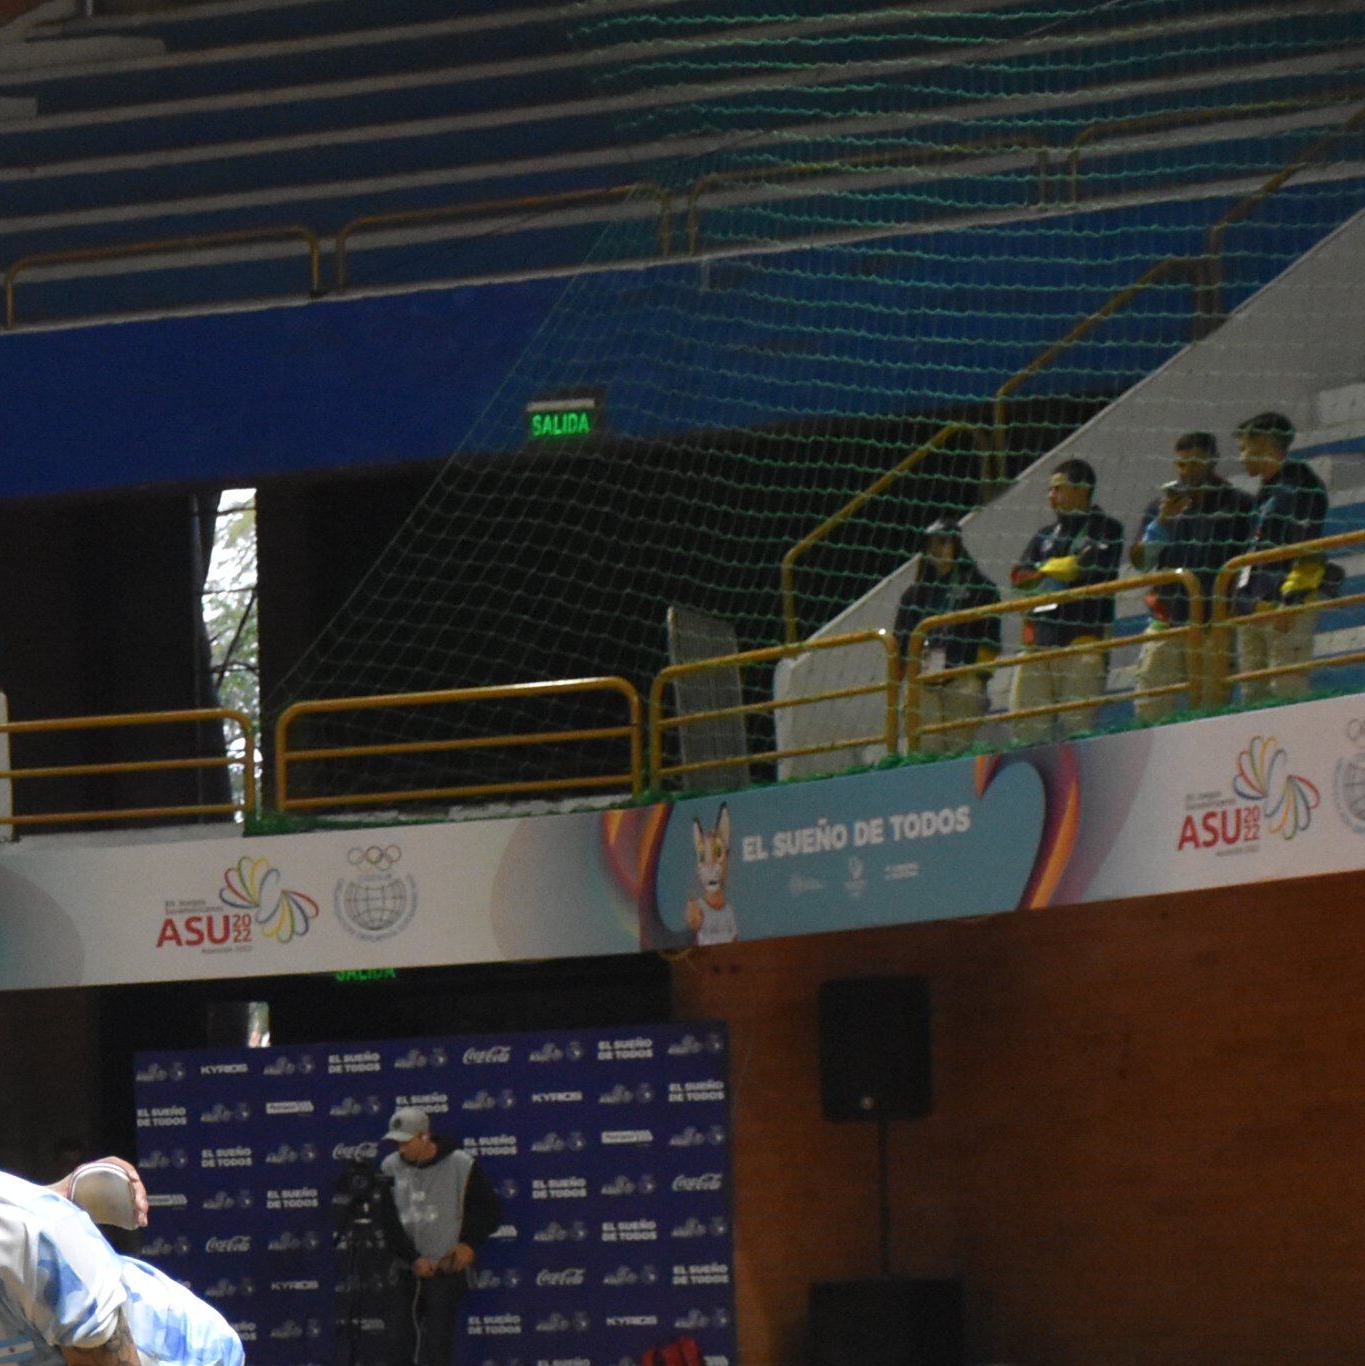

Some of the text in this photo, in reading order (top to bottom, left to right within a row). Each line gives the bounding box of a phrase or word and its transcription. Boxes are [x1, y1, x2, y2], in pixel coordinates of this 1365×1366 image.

[531, 412, 591, 436] SALIDA
[742, 805, 971, 863] EL SUEÑO DE TODOS
[1177, 808, 1241, 852] ASU
[156, 914, 230, 947] ASU
